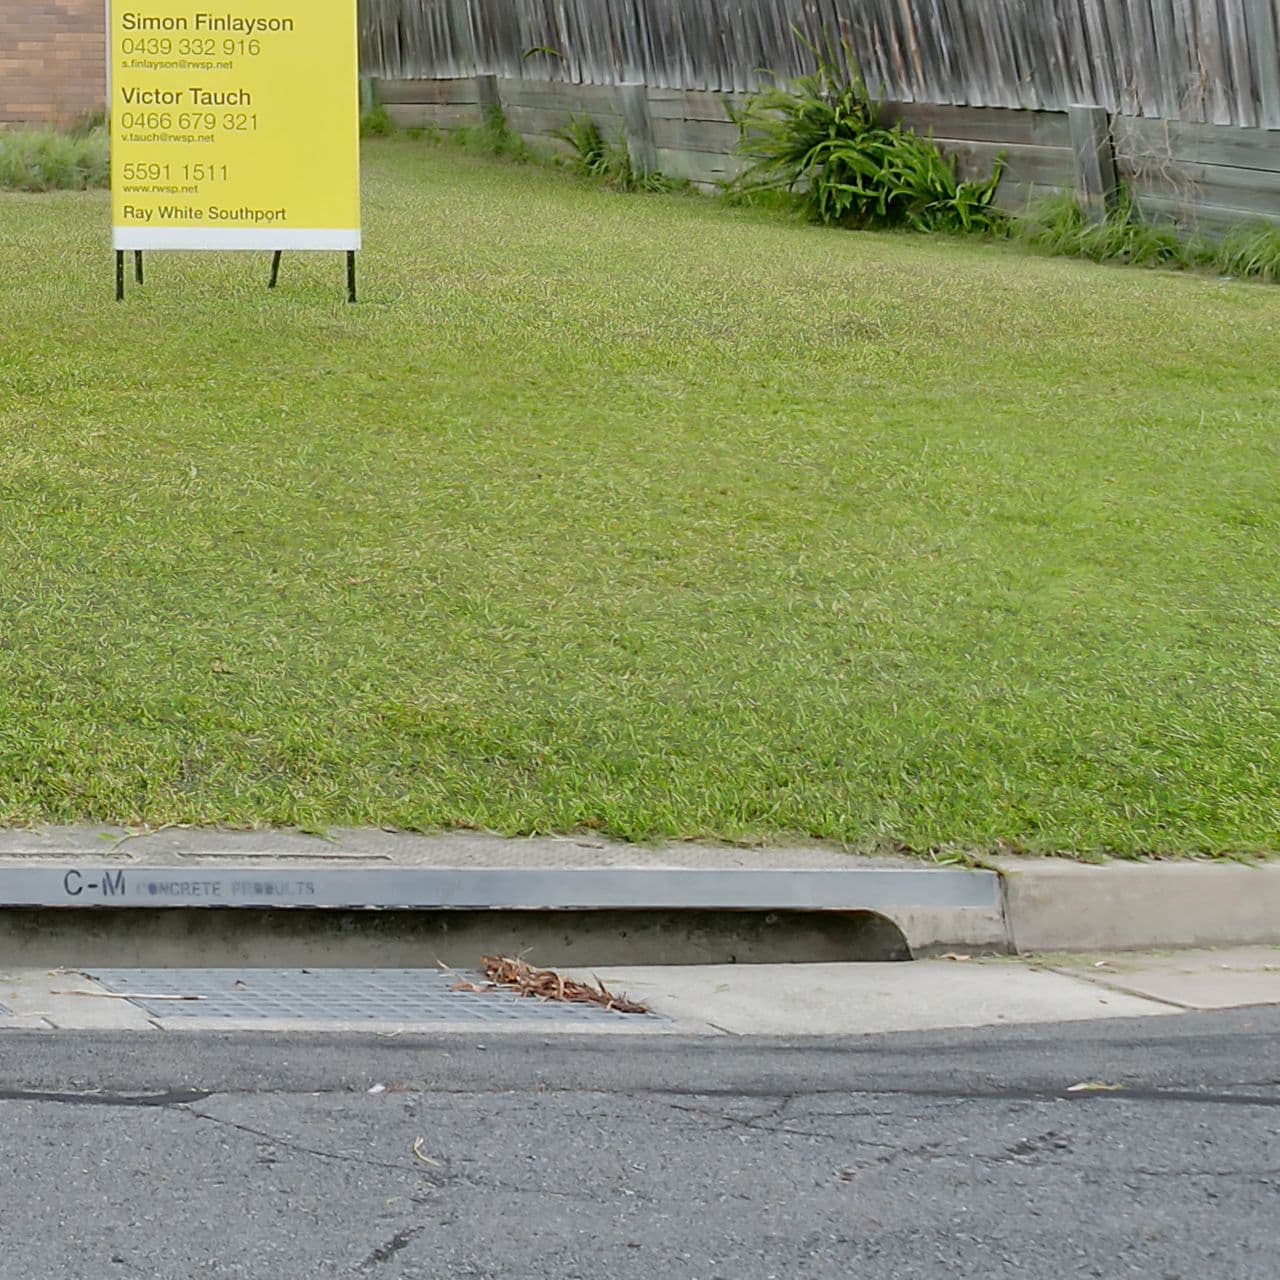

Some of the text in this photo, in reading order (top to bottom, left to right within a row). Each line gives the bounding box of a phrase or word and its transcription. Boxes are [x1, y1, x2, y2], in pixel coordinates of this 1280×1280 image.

[121, 12, 294, 36] Simon Finlayson
[121, 37, 261, 56] 0439 332 916
[121, 87, 251, 106] Victor Tauch
[121, 111, 257, 131] 0466 679 321
[122, 162, 227, 182] 5591 1511
[122, 184, 198, 195] www.rwsp.net
[123, 205, 287, 224] Ray White Southport
[63, 869, 126, 897] C-M
